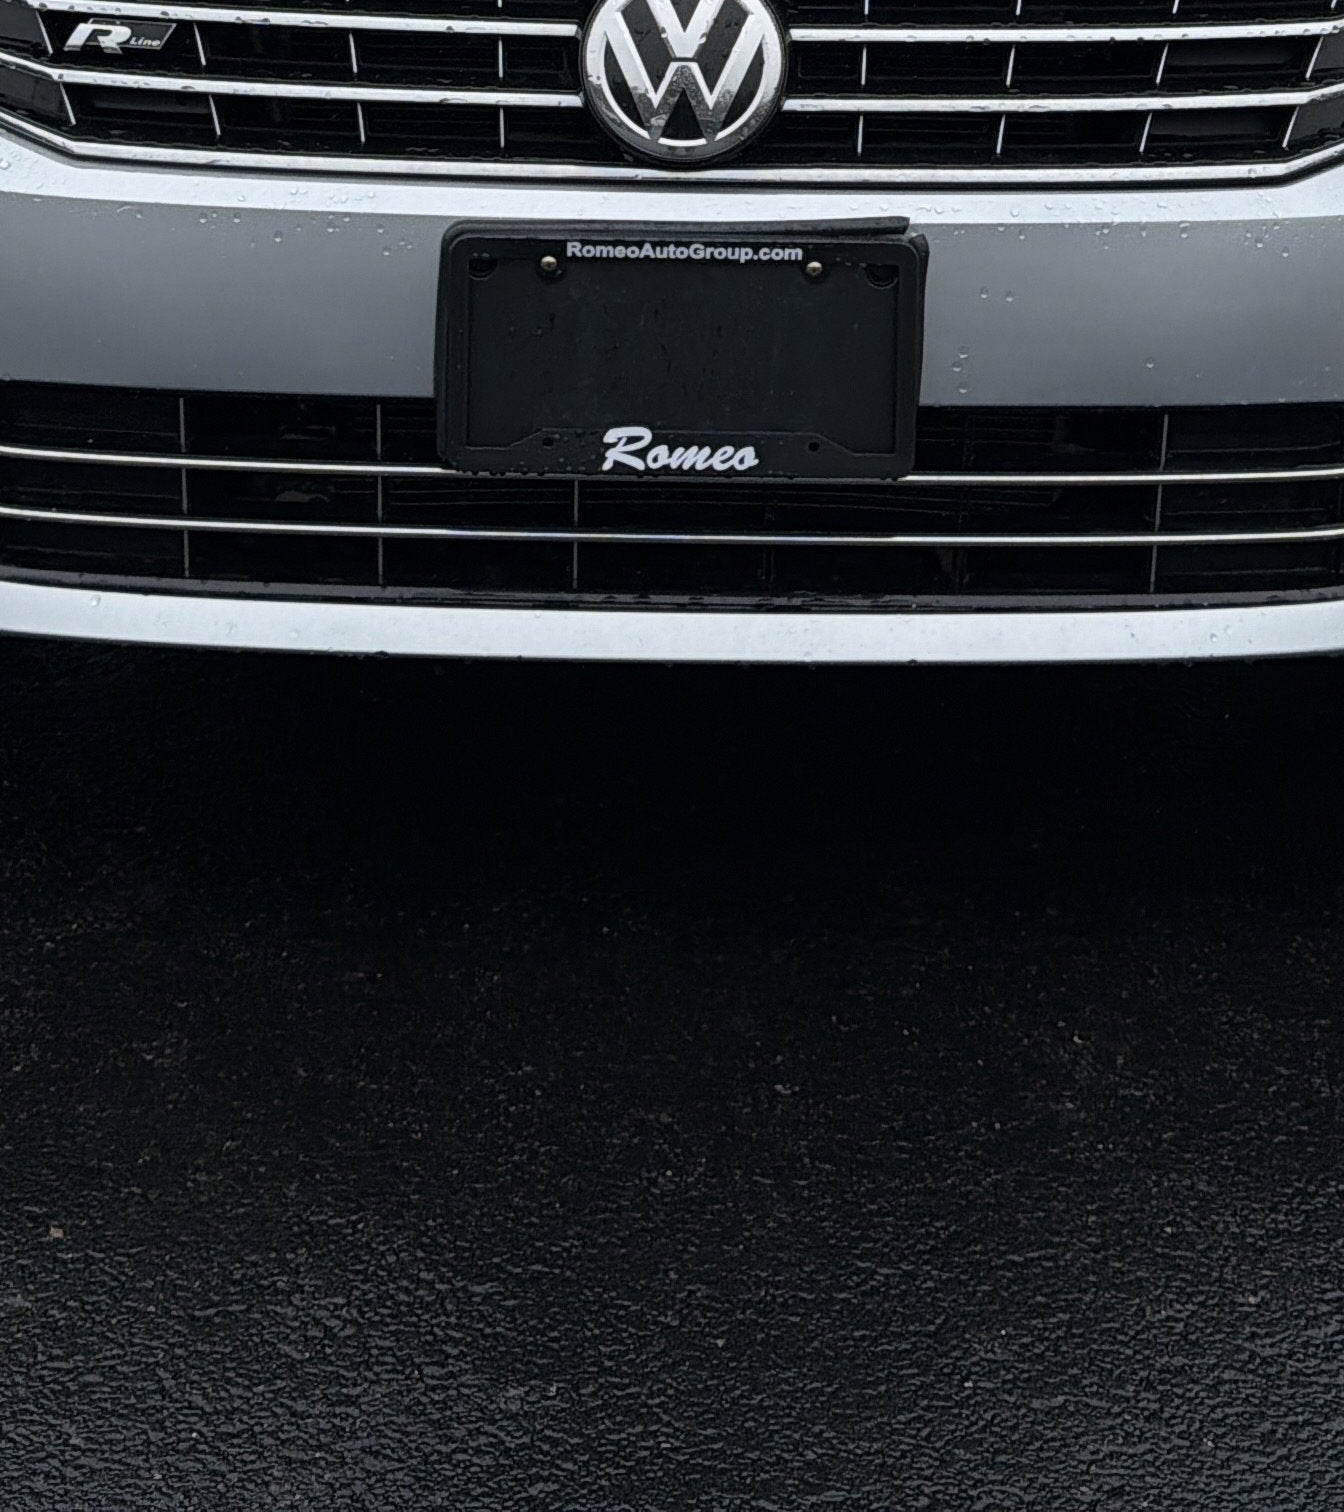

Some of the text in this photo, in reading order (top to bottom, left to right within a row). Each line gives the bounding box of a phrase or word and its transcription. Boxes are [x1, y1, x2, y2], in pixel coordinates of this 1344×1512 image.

[63, 22, 162, 55] R Line
[565, 240, 804, 264] RomeoAutoGroup.com
[601, 425, 760, 472] Romeo
